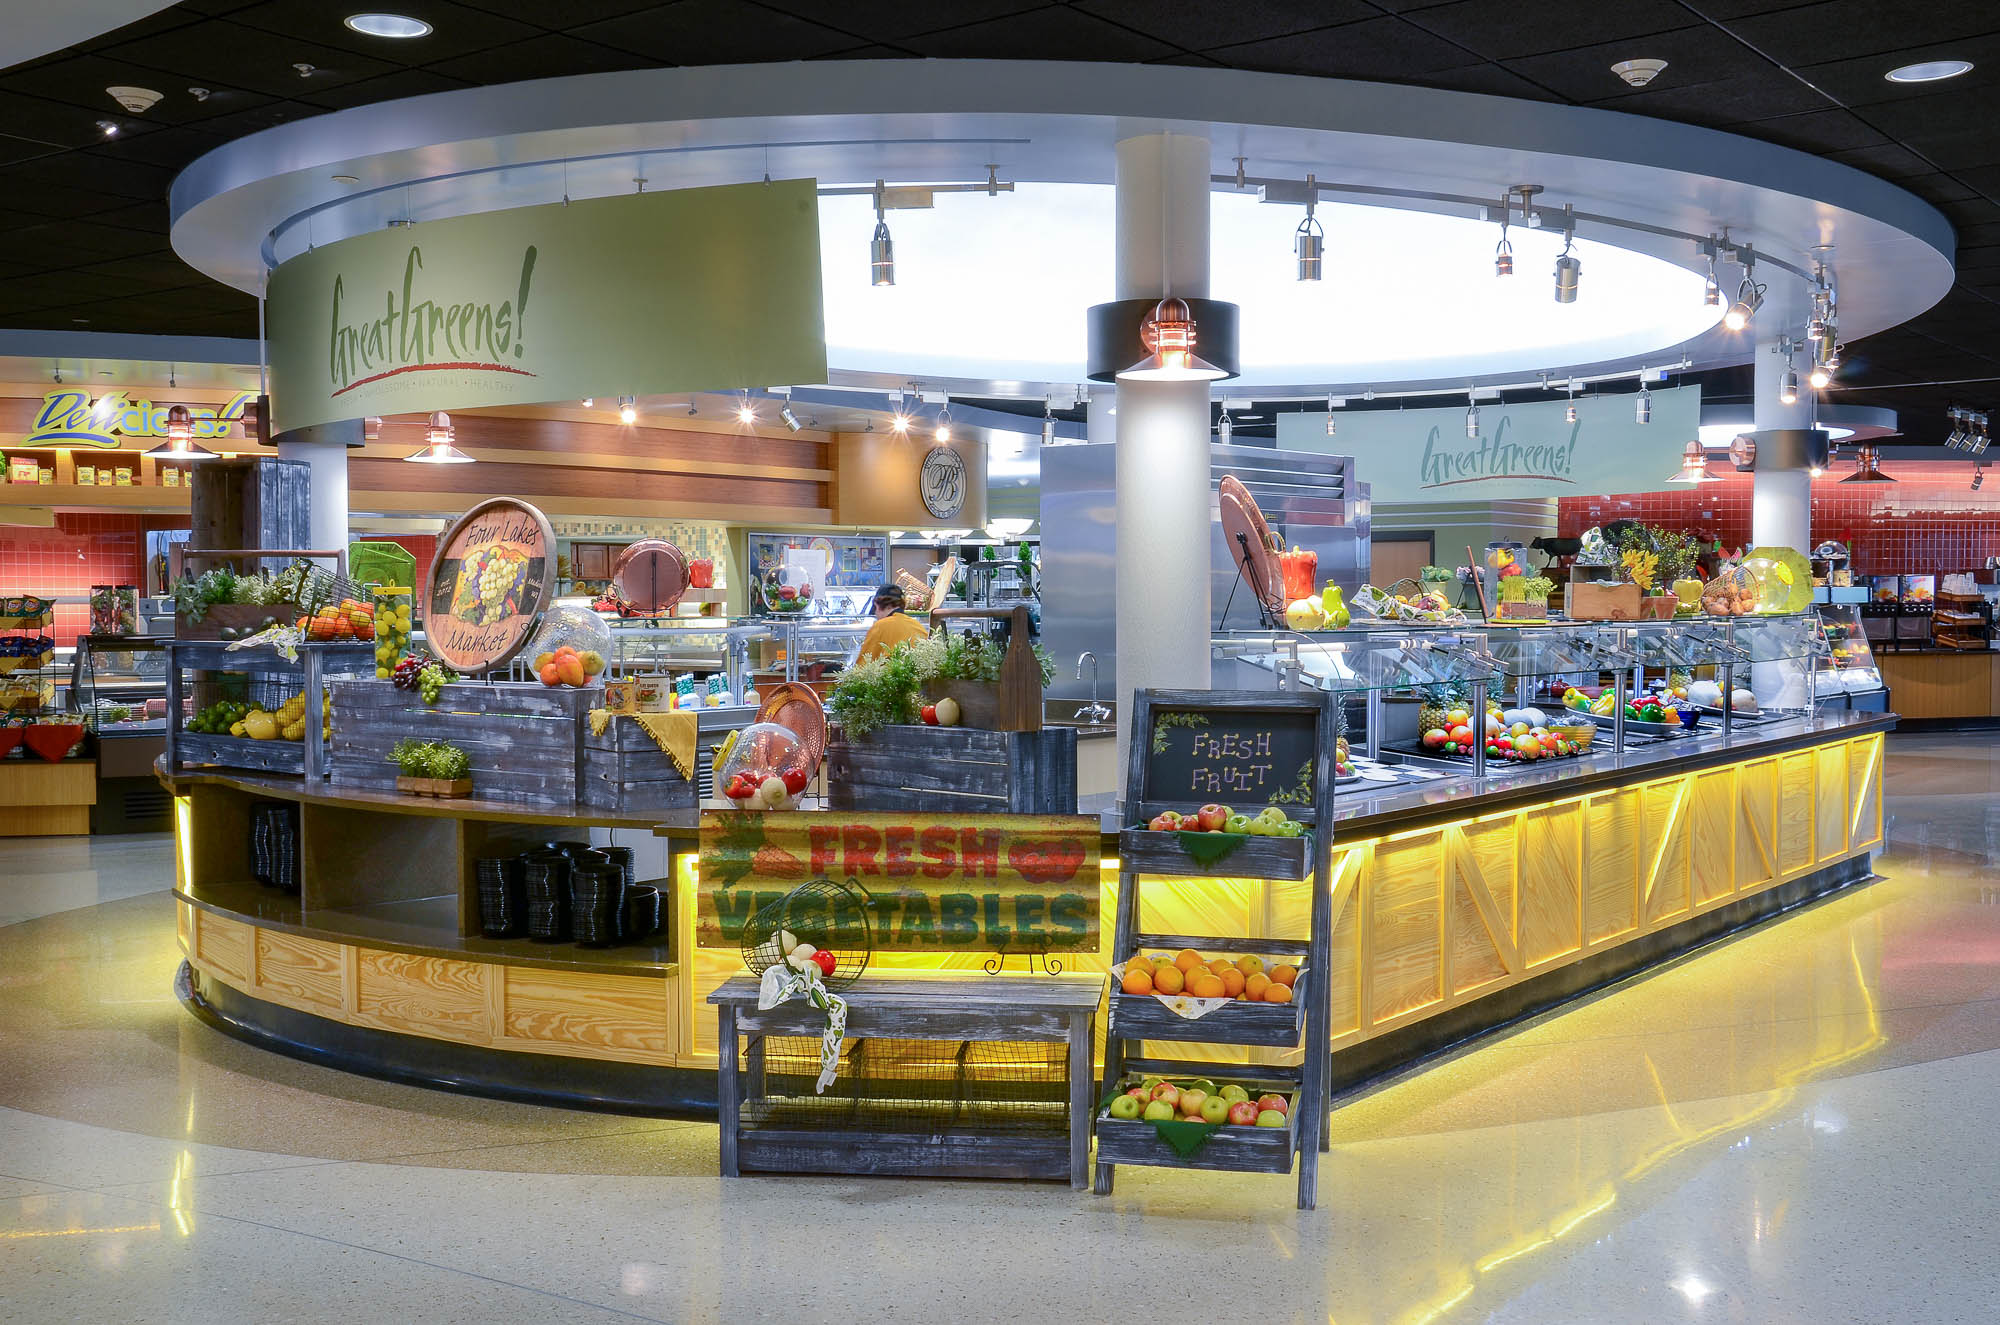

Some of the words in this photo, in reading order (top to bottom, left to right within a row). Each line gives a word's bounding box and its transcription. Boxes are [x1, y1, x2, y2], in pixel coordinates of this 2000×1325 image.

[400, 245, 537, 366] Greens!
[37, 391, 252, 433] Delicios!
[465, 524, 502, 548] Four
[501, 516, 539, 545] Lakes
[446, 625, 508, 652] Market
[1192, 732, 1272, 759] FRESH
[1191, 764, 1272, 793] FRUIT
[808, 824, 999, 880] FRESH
[712, 889, 1088, 946] VEGETABLES
